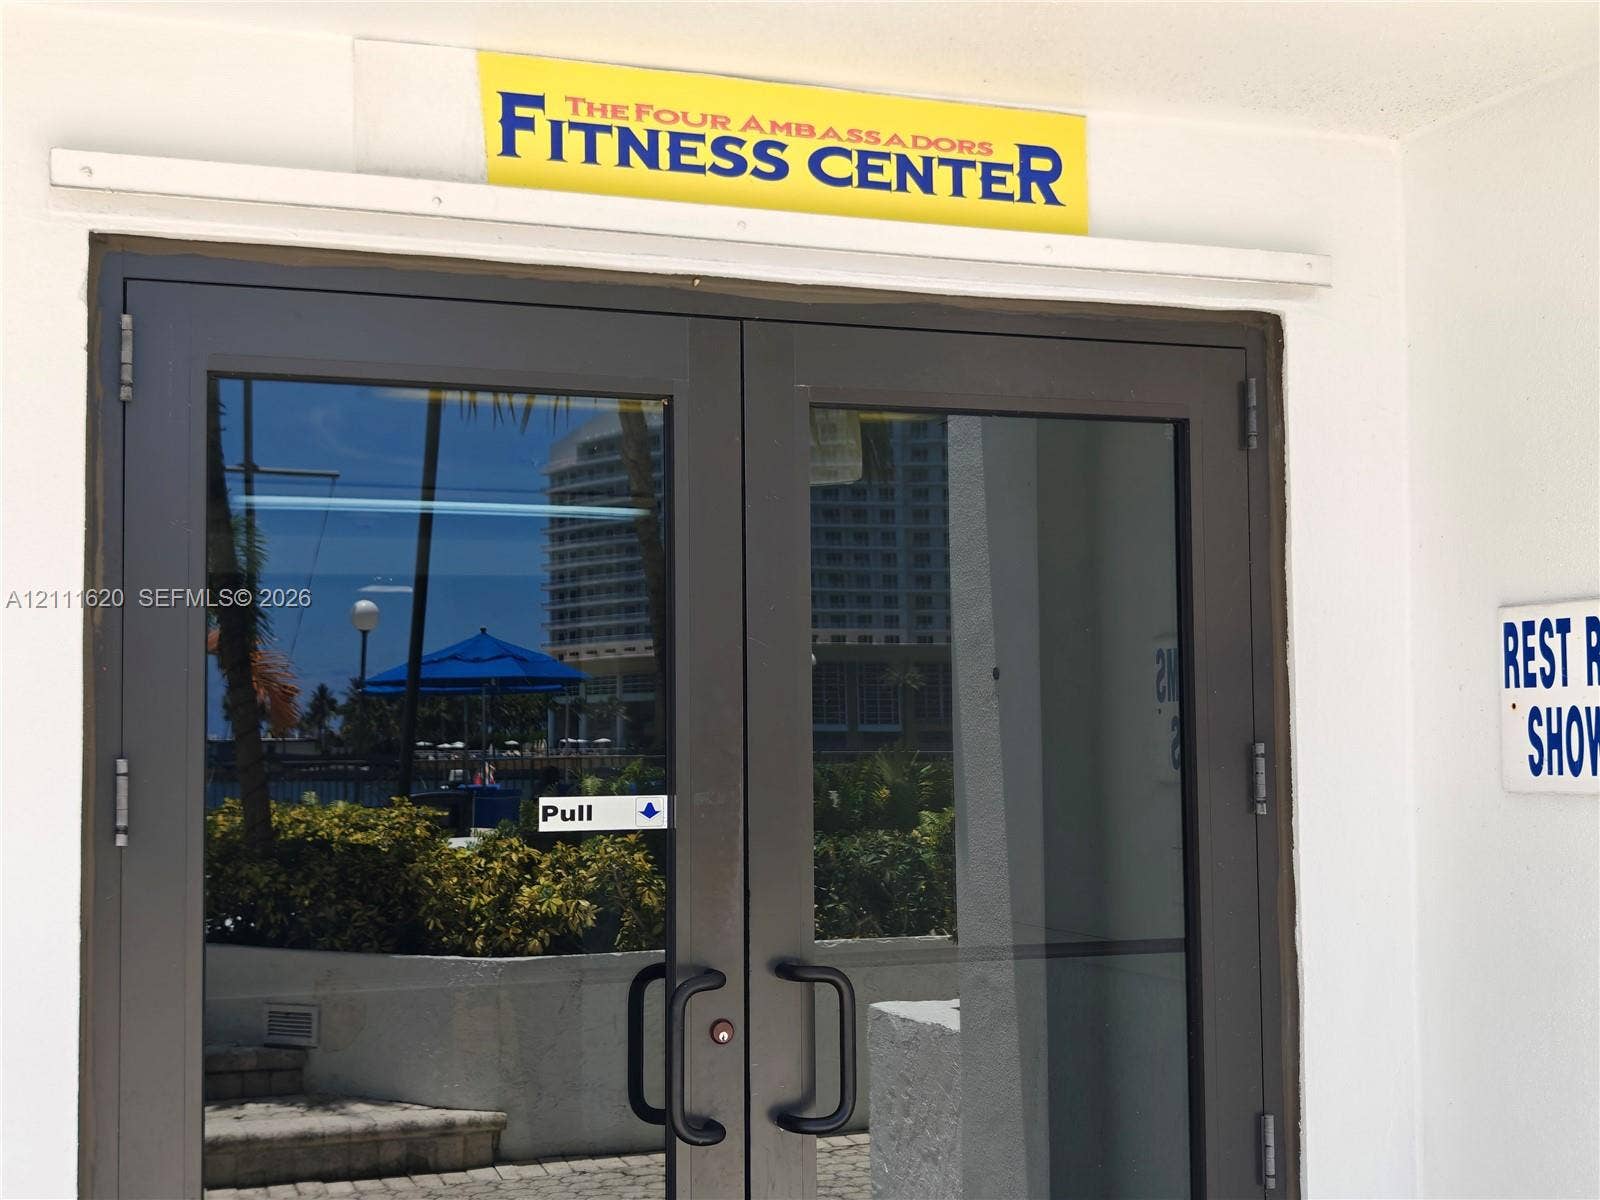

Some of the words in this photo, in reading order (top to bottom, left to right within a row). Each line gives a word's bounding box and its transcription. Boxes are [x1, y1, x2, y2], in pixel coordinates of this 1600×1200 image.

[496, 90, 790, 182] FITNESS
[807, 142, 1067, 207] CENTER
[564, 95, 630, 121] THE
[634, 102, 732, 131] FOUR
[738, 114, 994, 157] AMBASSADORS
[1503, 617, 1572, 690] REST
[541, 804, 593, 823] Pull
